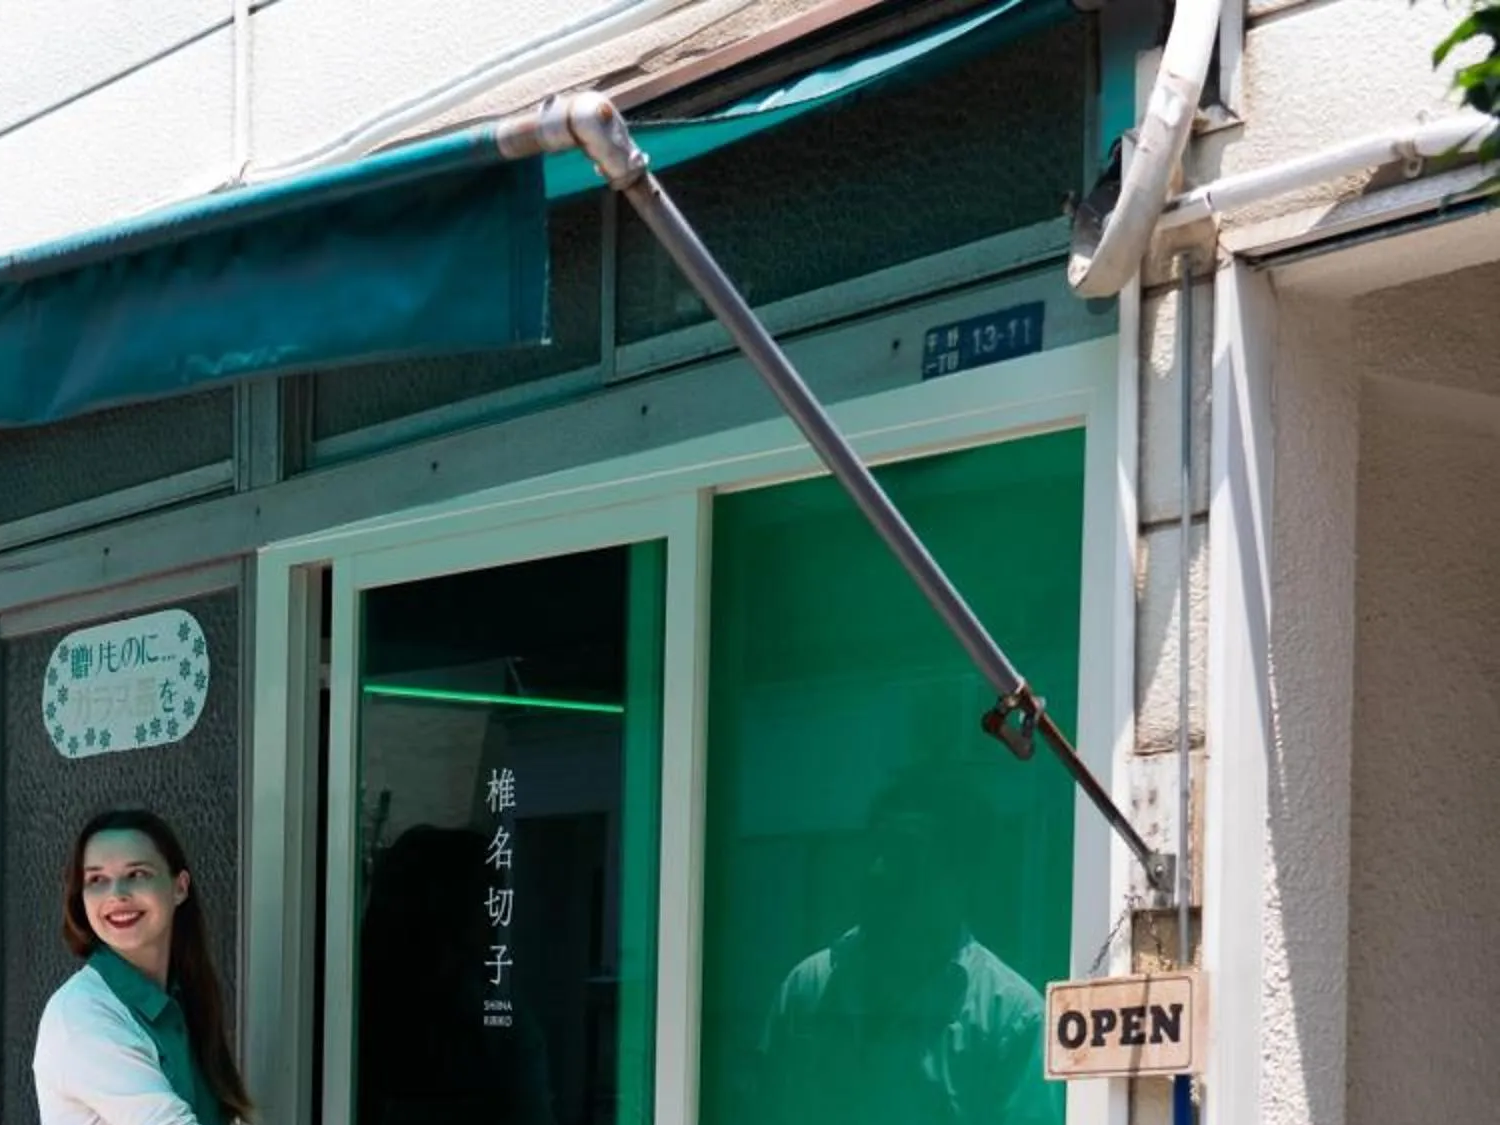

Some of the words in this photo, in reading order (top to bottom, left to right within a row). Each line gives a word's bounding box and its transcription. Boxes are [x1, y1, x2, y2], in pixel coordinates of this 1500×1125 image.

[973, 317, 1031, 355] 13-11
[484, 768, 517, 986] 椎名切子
[1057, 1003, 1184, 1050] OPEN
